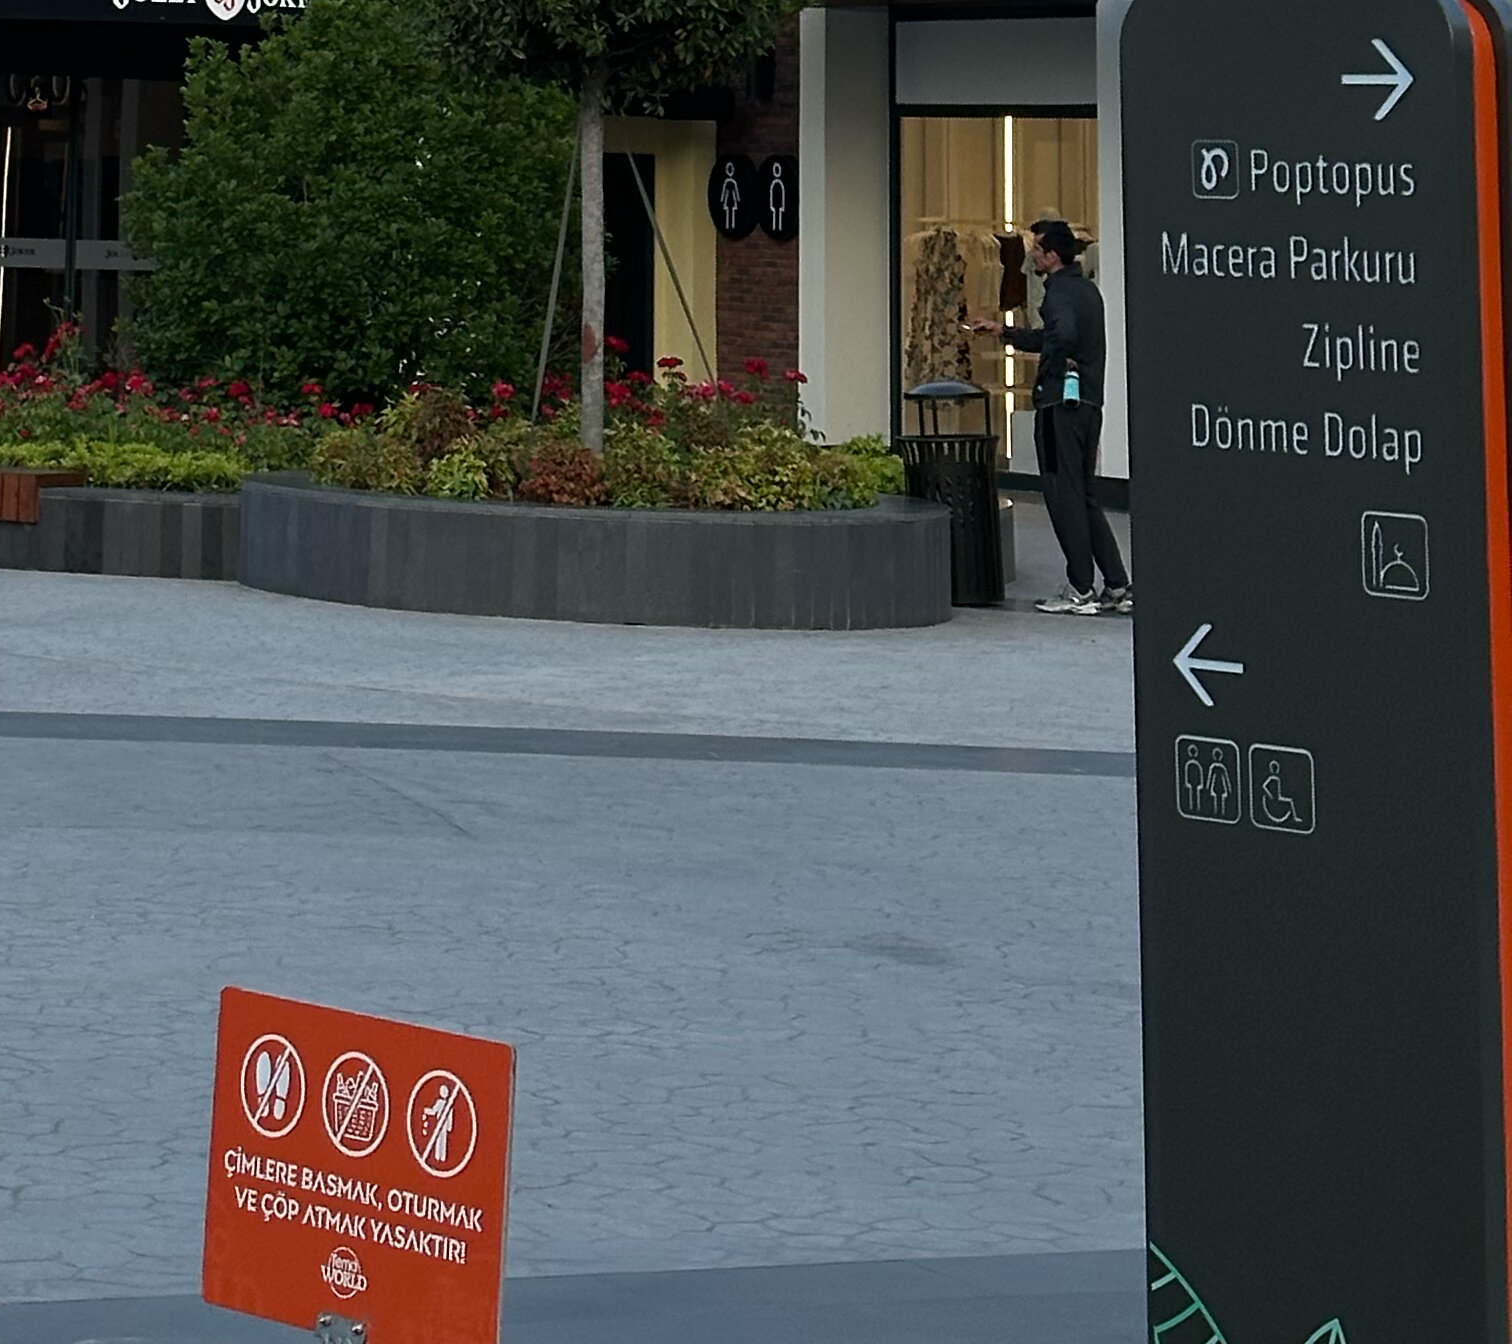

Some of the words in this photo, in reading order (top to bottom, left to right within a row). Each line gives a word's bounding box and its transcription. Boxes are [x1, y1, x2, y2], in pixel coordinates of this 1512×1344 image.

[1250, 149, 1415, 208] Poptopus
[1161, 231, 1276, 279] Macera
[1290, 235, 1415, 285] Parkuru
[1302, 322, 1420, 382] Zipline
[1191, 403, 1308, 455] Dönme
[1324, 411, 1422, 475] Dolap
[224, 1146, 298, 1187] ÇİMLERE
[301, 1167, 382, 1210] BASMAK,
[387, 1189, 483, 1232] OTURMAK
[234, 1186, 257, 1211] VE
[261, 1191, 299, 1222] ÇÖP
[302, 1204, 366, 1240] ATMAK
[370, 1221, 468, 1264] YASAKTIR!
[321, 1265, 367, 1291] WORLD
